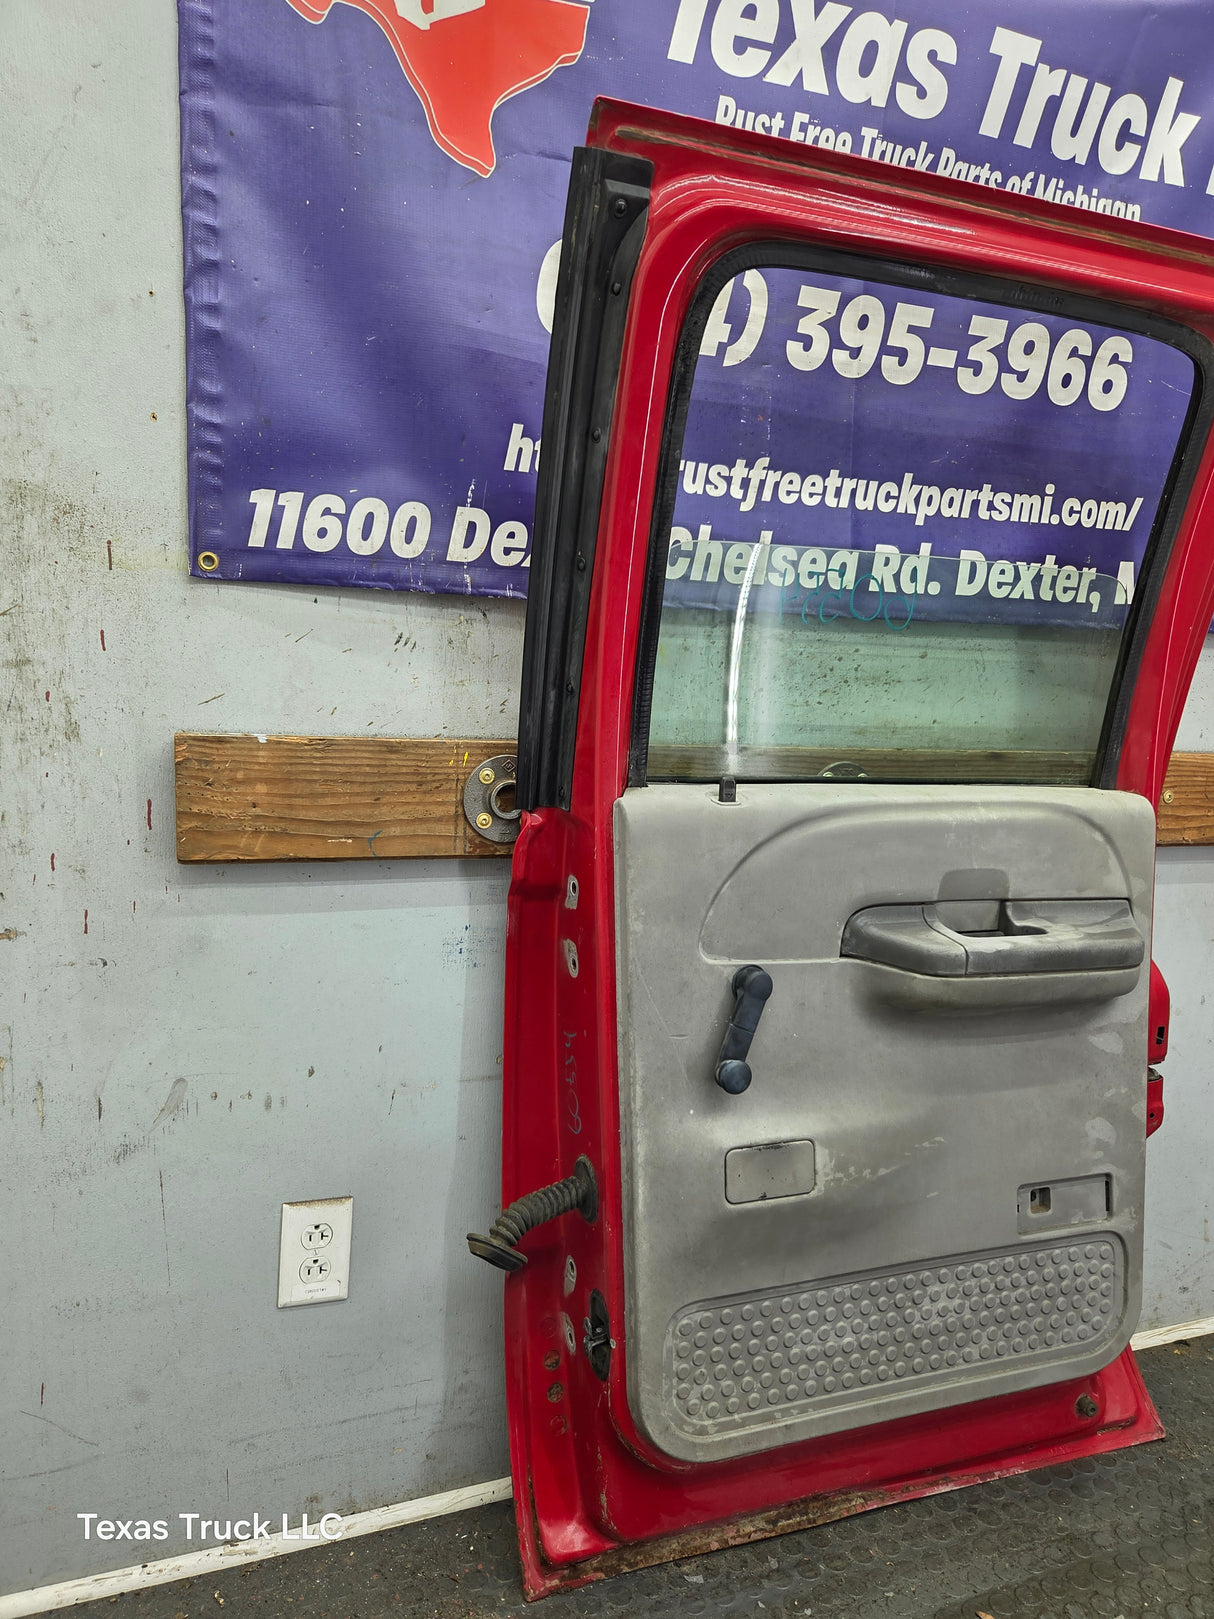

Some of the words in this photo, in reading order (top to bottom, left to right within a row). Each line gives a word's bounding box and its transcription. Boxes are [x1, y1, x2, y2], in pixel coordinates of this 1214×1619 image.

[978, 26, 1201, 187] Truck
[790, 111, 853, 154] Free
[861, 126, 935, 174] Truck
[936, 146, 1003, 189] Parts
[1005, 171, 1035, 195] of
[785, 285, 1133, 412] 395-3966
[247, 488, 432, 559] 11600
[665, 523, 860, 591] Chelsea
[868, 542, 941, 596] Rd.
[954, 549, 1101, 613] Dexter,
